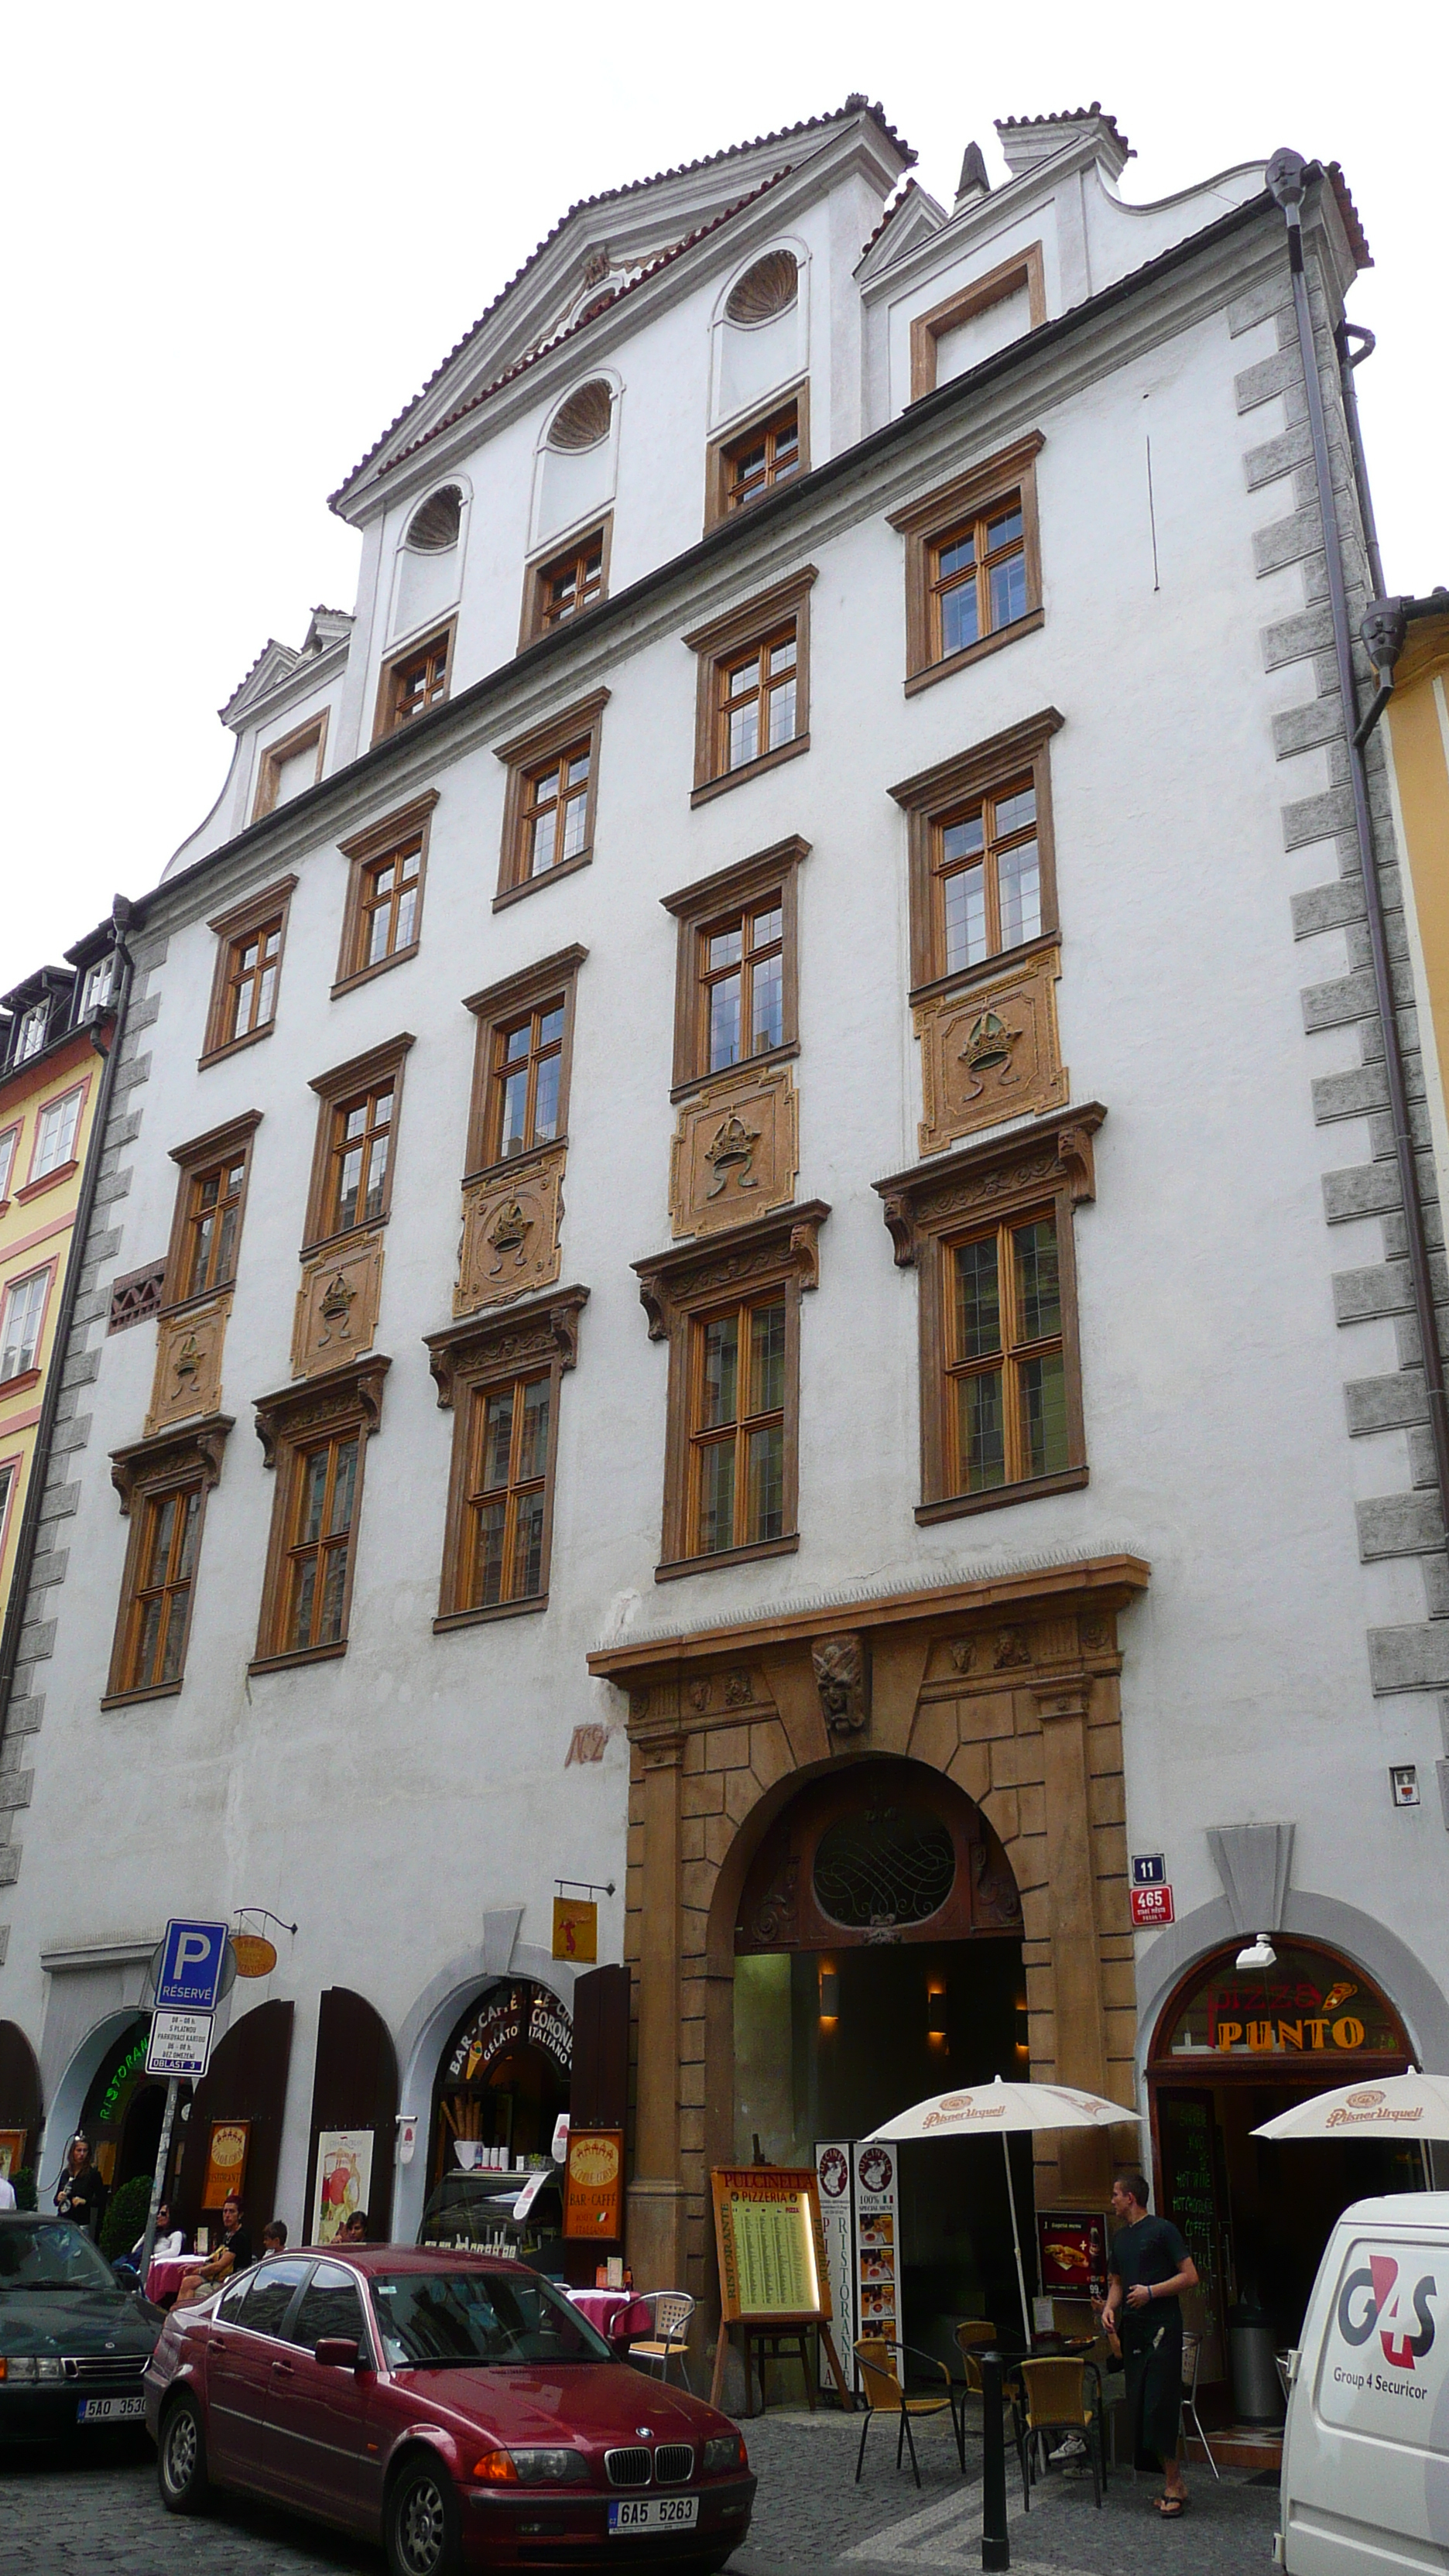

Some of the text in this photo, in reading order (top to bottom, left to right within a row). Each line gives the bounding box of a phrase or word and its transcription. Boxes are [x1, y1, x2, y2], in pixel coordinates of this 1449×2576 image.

[1140, 1861, 1153, 1879] 11
[1138, 1890, 1163, 1907] 465
[173, 1931, 211, 1980] P
[163, 1984, 212, 2000] RÉSERVÉ
[483, 2025, 518, 2060] GELATO
[529, 2025, 567, 2064] ITALIANO
[1218, 2016, 1365, 2051] PUNTO
[153, 2059, 185, 2069] OBLAST
[449, 2034, 473, 2075] BAR
[922, 2105, 1005, 2129] Pilsner Urquell
[1325, 2107, 1423, 2129] Pilsner Urquell
[724, 2173, 814, 2190] PULCINELLA
[570, 2193, 587, 2205] BAR
[742, 2191, 787, 2203] PIZZERIA
[859, 2195, 880, 2205] 100%
[720, 2203, 736, 2299] RISTORANTE
[1338, 2255, 1437, 2370] G4S
[1334, 2366, 1427, 2400] Group 4 Securicor
[621, 2499, 693, 2523] 6A5 5263
